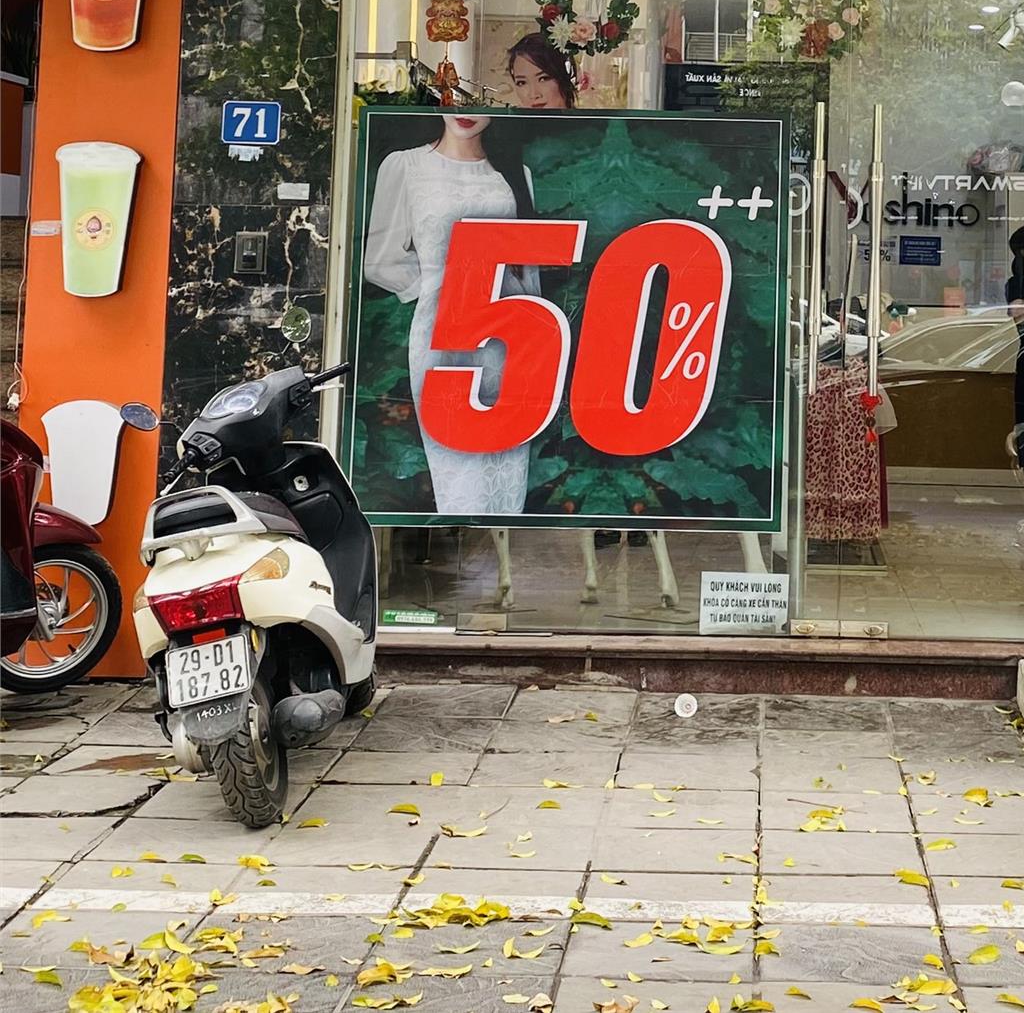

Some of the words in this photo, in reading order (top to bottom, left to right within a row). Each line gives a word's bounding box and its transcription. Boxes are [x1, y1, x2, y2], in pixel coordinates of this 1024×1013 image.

[232, 107, 267, 138] 71
[827, 171, 980, 227] Yshino
[180, 641, 234, 674] 29-D1
[176, 665, 245, 702] 187.82
